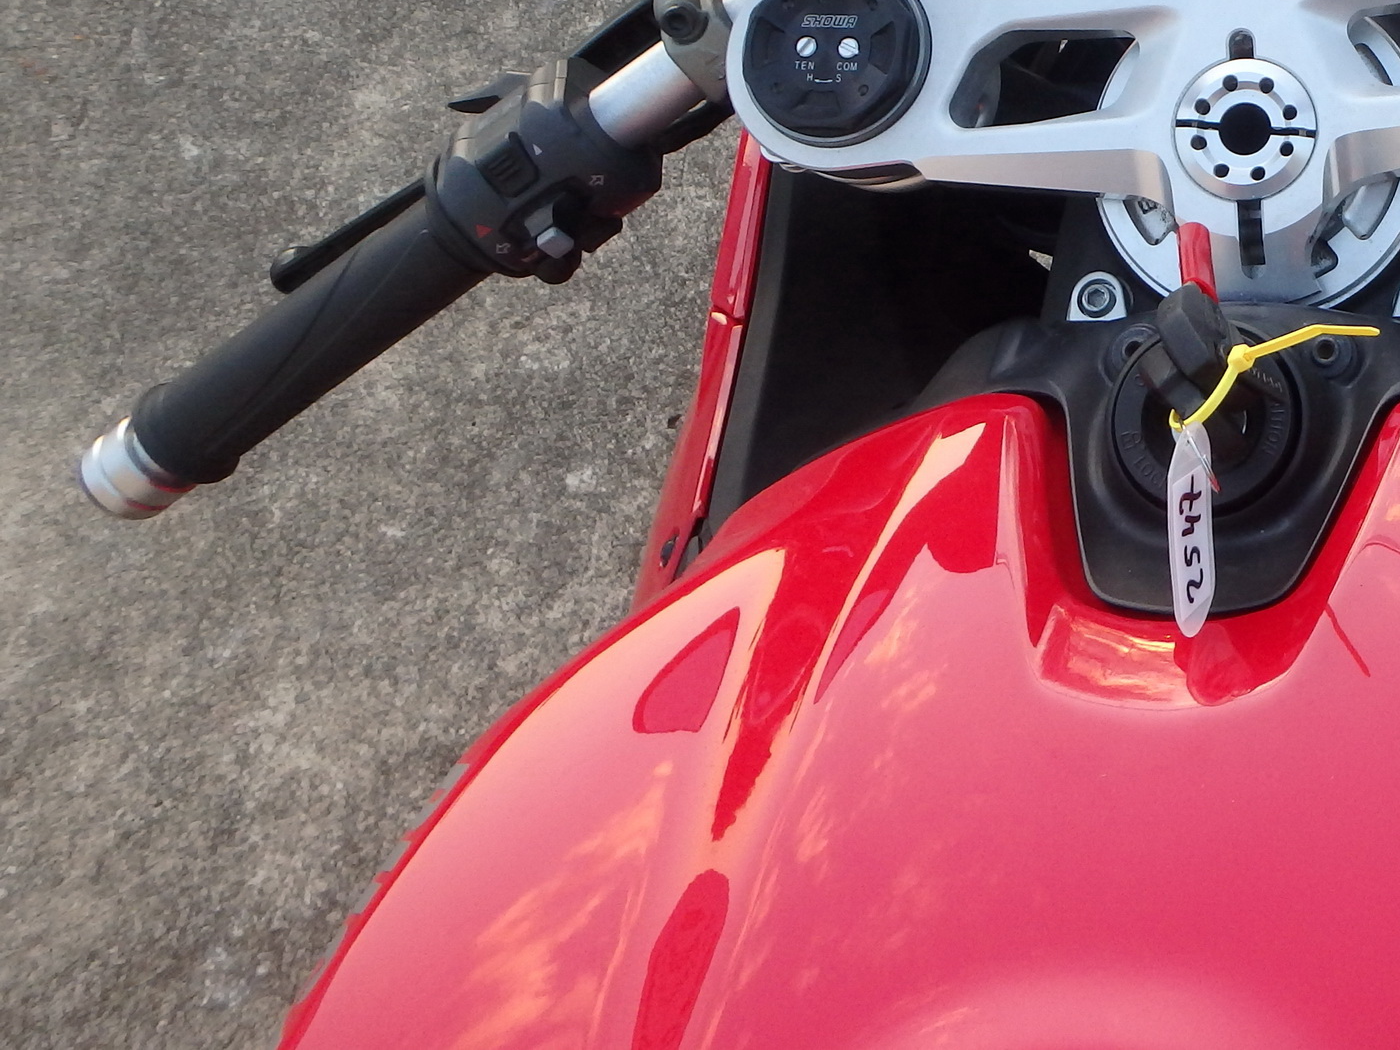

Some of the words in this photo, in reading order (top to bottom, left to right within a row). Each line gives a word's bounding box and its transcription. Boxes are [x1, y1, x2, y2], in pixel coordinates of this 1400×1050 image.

[801, 14, 858, 29] SHOWA
[794, 61, 815, 71] TEN
[836, 62, 858, 72] COM
[806, 73, 813, 82] H
[835, 73, 842, 83] S
[1178, 473, 1204, 604] 2547
